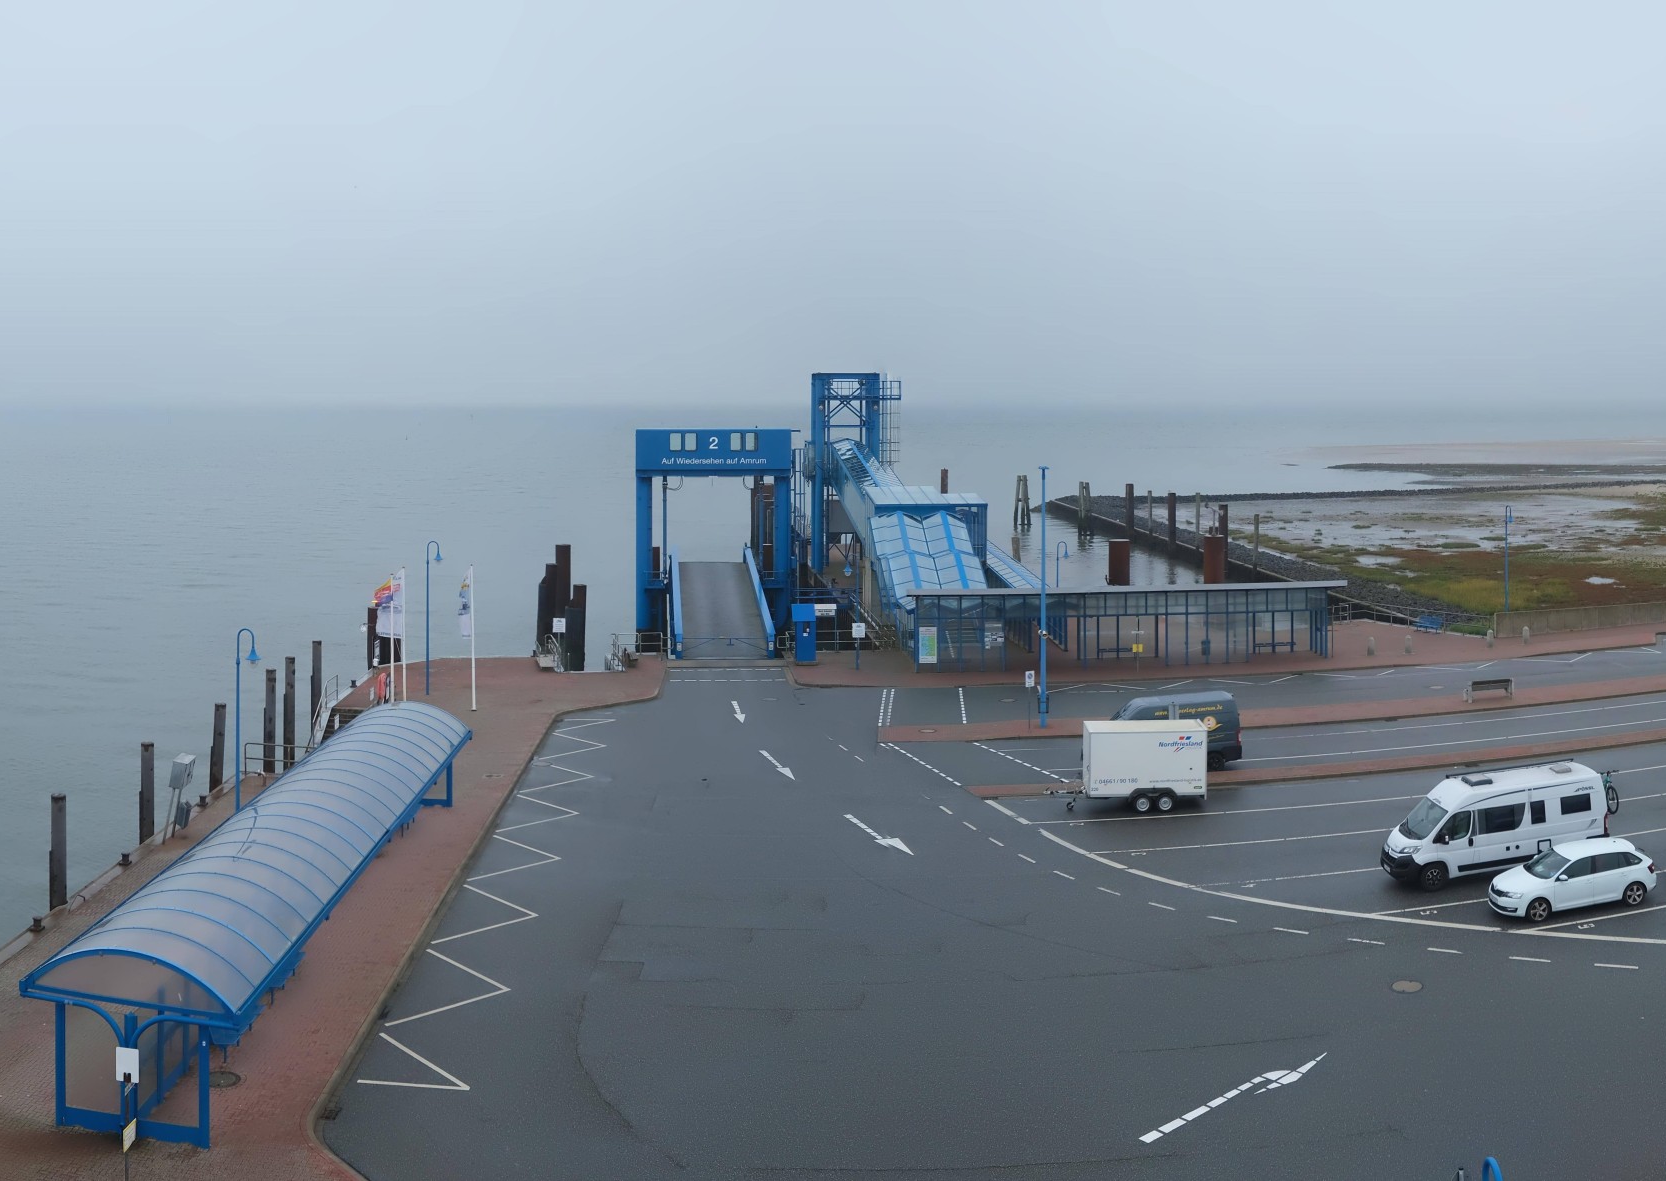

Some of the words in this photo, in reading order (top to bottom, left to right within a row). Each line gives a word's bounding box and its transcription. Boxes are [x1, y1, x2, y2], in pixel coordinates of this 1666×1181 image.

[709, 437, 719, 449] 2
[661, 457, 674, 465] Auf
[676, 457, 724, 465] Wiedersehen
[726, 457, 738, 465] auf
[1158, 740, 1203, 748] Nordfriesland
